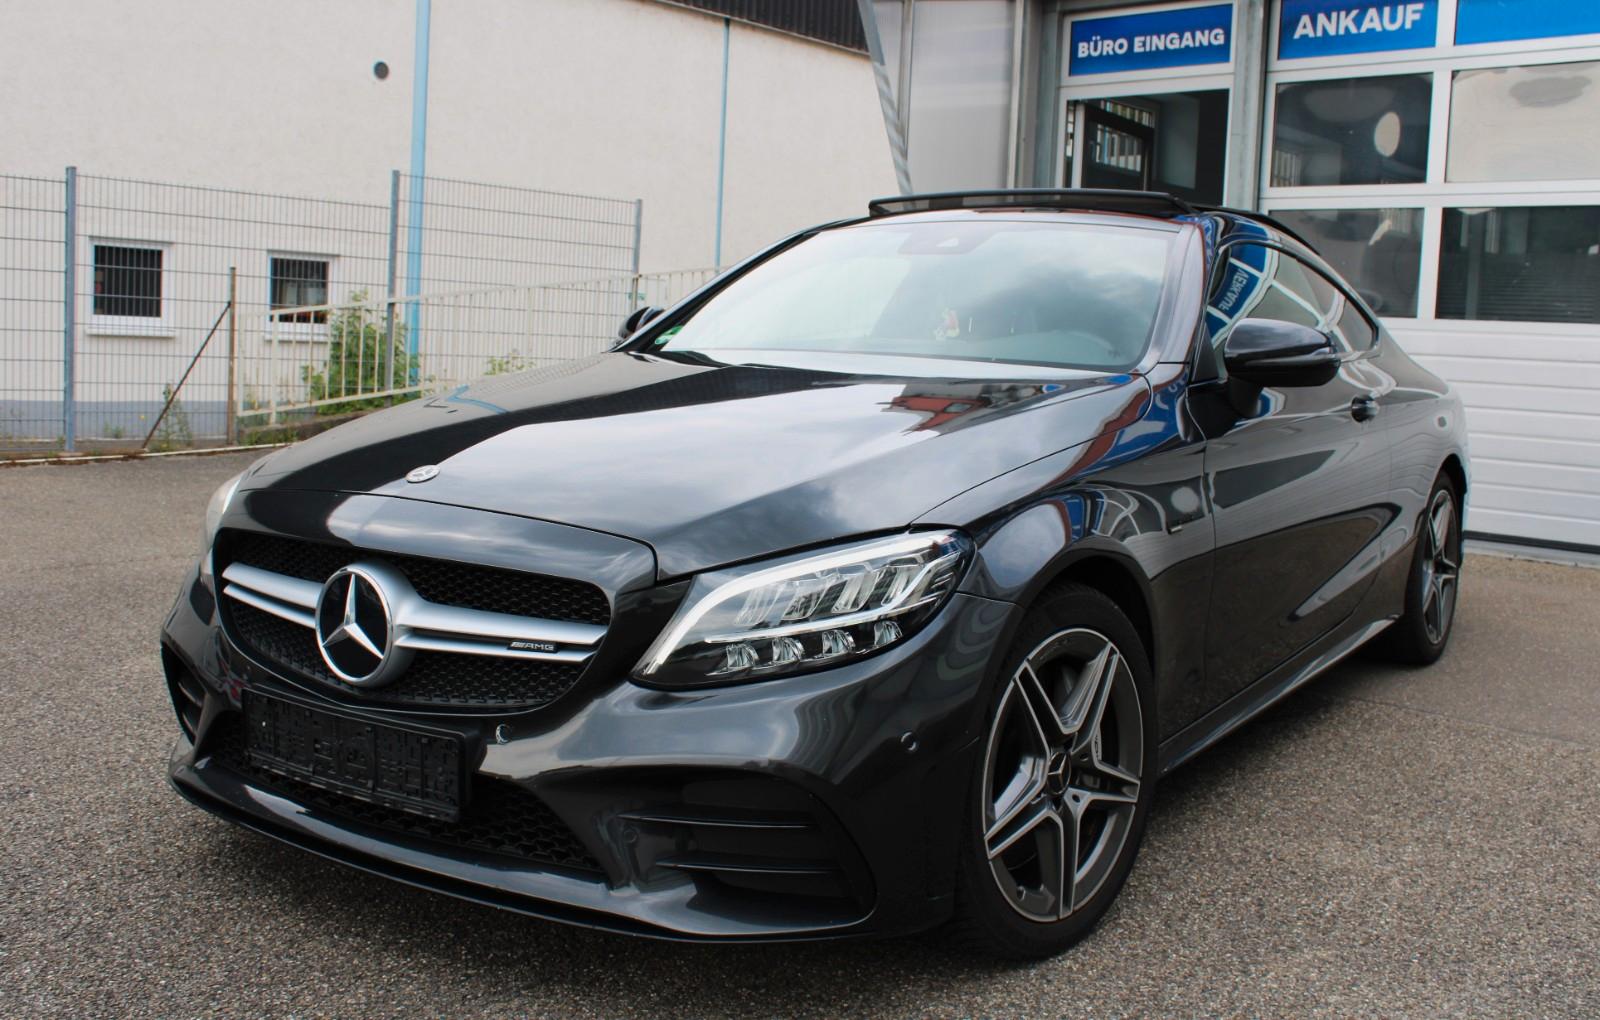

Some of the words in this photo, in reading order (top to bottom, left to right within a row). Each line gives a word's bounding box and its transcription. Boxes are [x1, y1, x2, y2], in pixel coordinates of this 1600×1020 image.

[1293, 3, 1425, 39] ANKAUF
[1077, 36, 1128, 58] BÜRO
[1133, 28, 1225, 53] EINGANG
